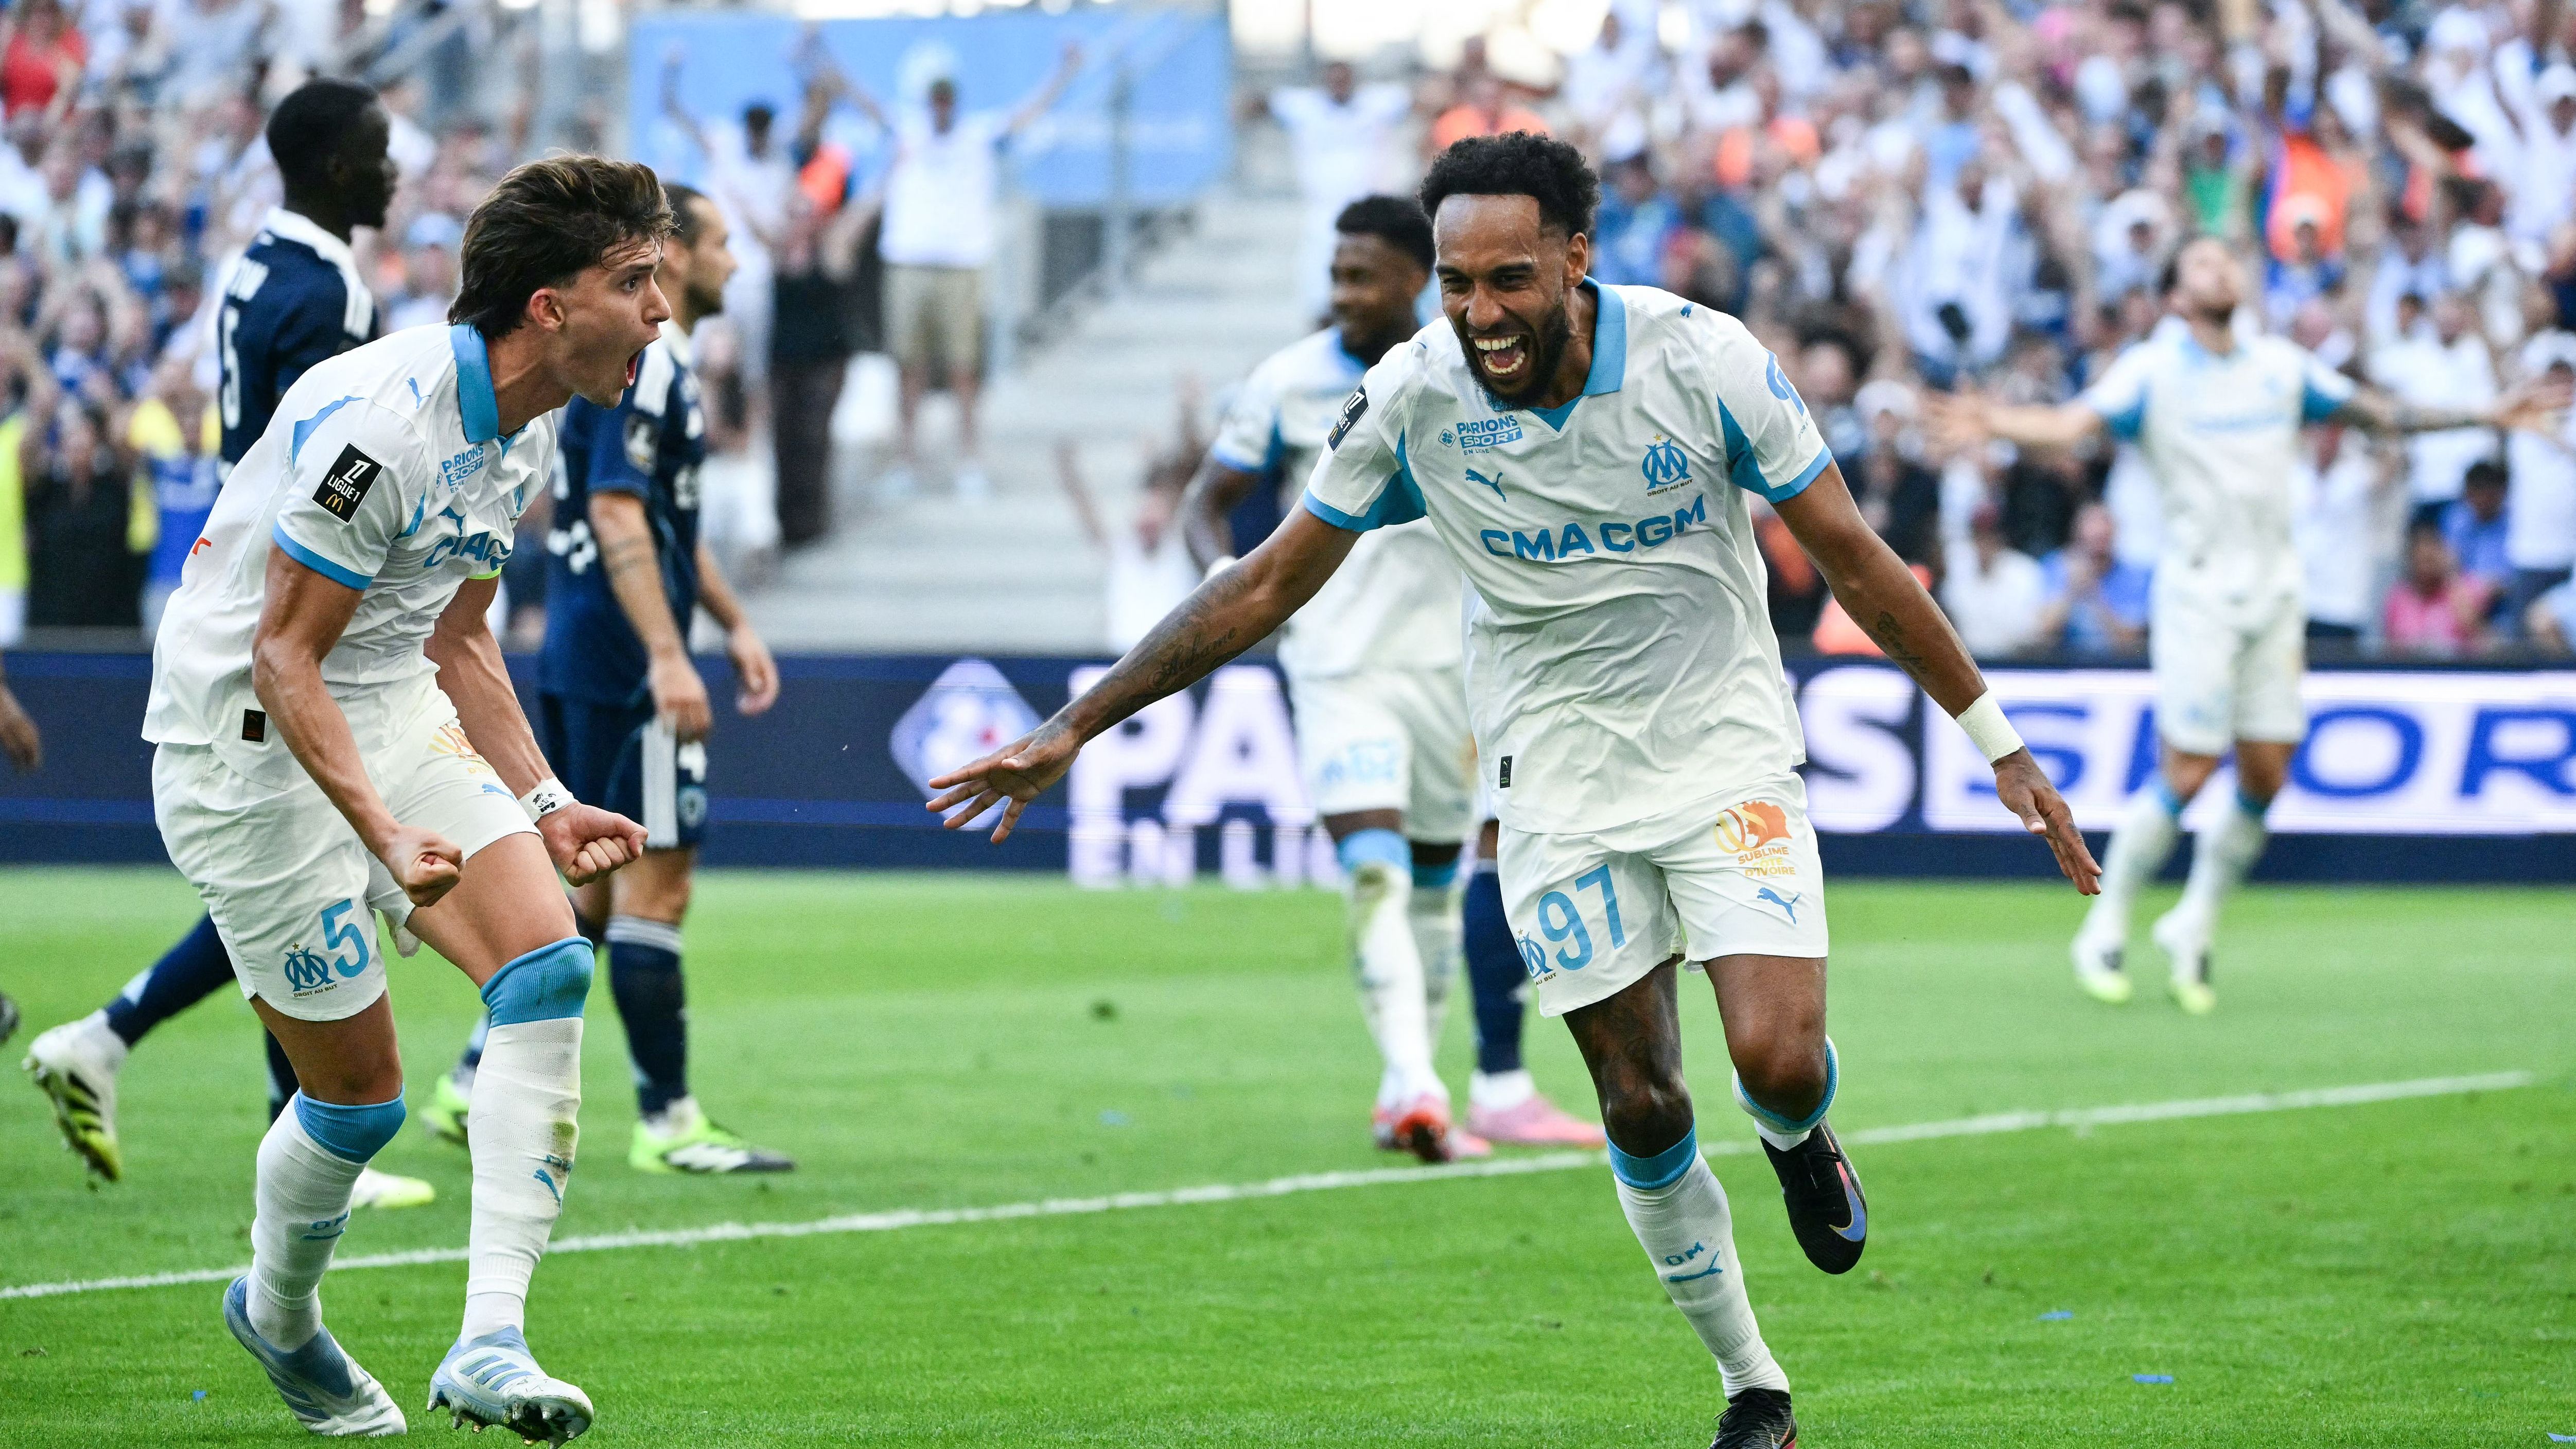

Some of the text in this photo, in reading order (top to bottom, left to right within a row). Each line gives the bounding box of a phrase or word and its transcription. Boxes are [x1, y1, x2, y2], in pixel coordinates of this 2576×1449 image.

[1456, 414, 1518, 435] PARIONS
[1463, 428, 1520, 447] SPORT
[327, 474, 360, 502] LIGUE 1
[1647, 487, 1668, 497] DROIT
[1679, 479, 1693, 487] BUT
[1480, 496, 1706, 562] CMA CGM
[1738, 846, 1789, 865] SUBLIME
[1745, 866, 1796, 876] D'IVOIRE
[1537, 863, 1626, 971] 97
[321, 898, 370, 978] 5
[1544, 972, 1556, 982] BUT
[293, 990, 313, 998] DROIT
